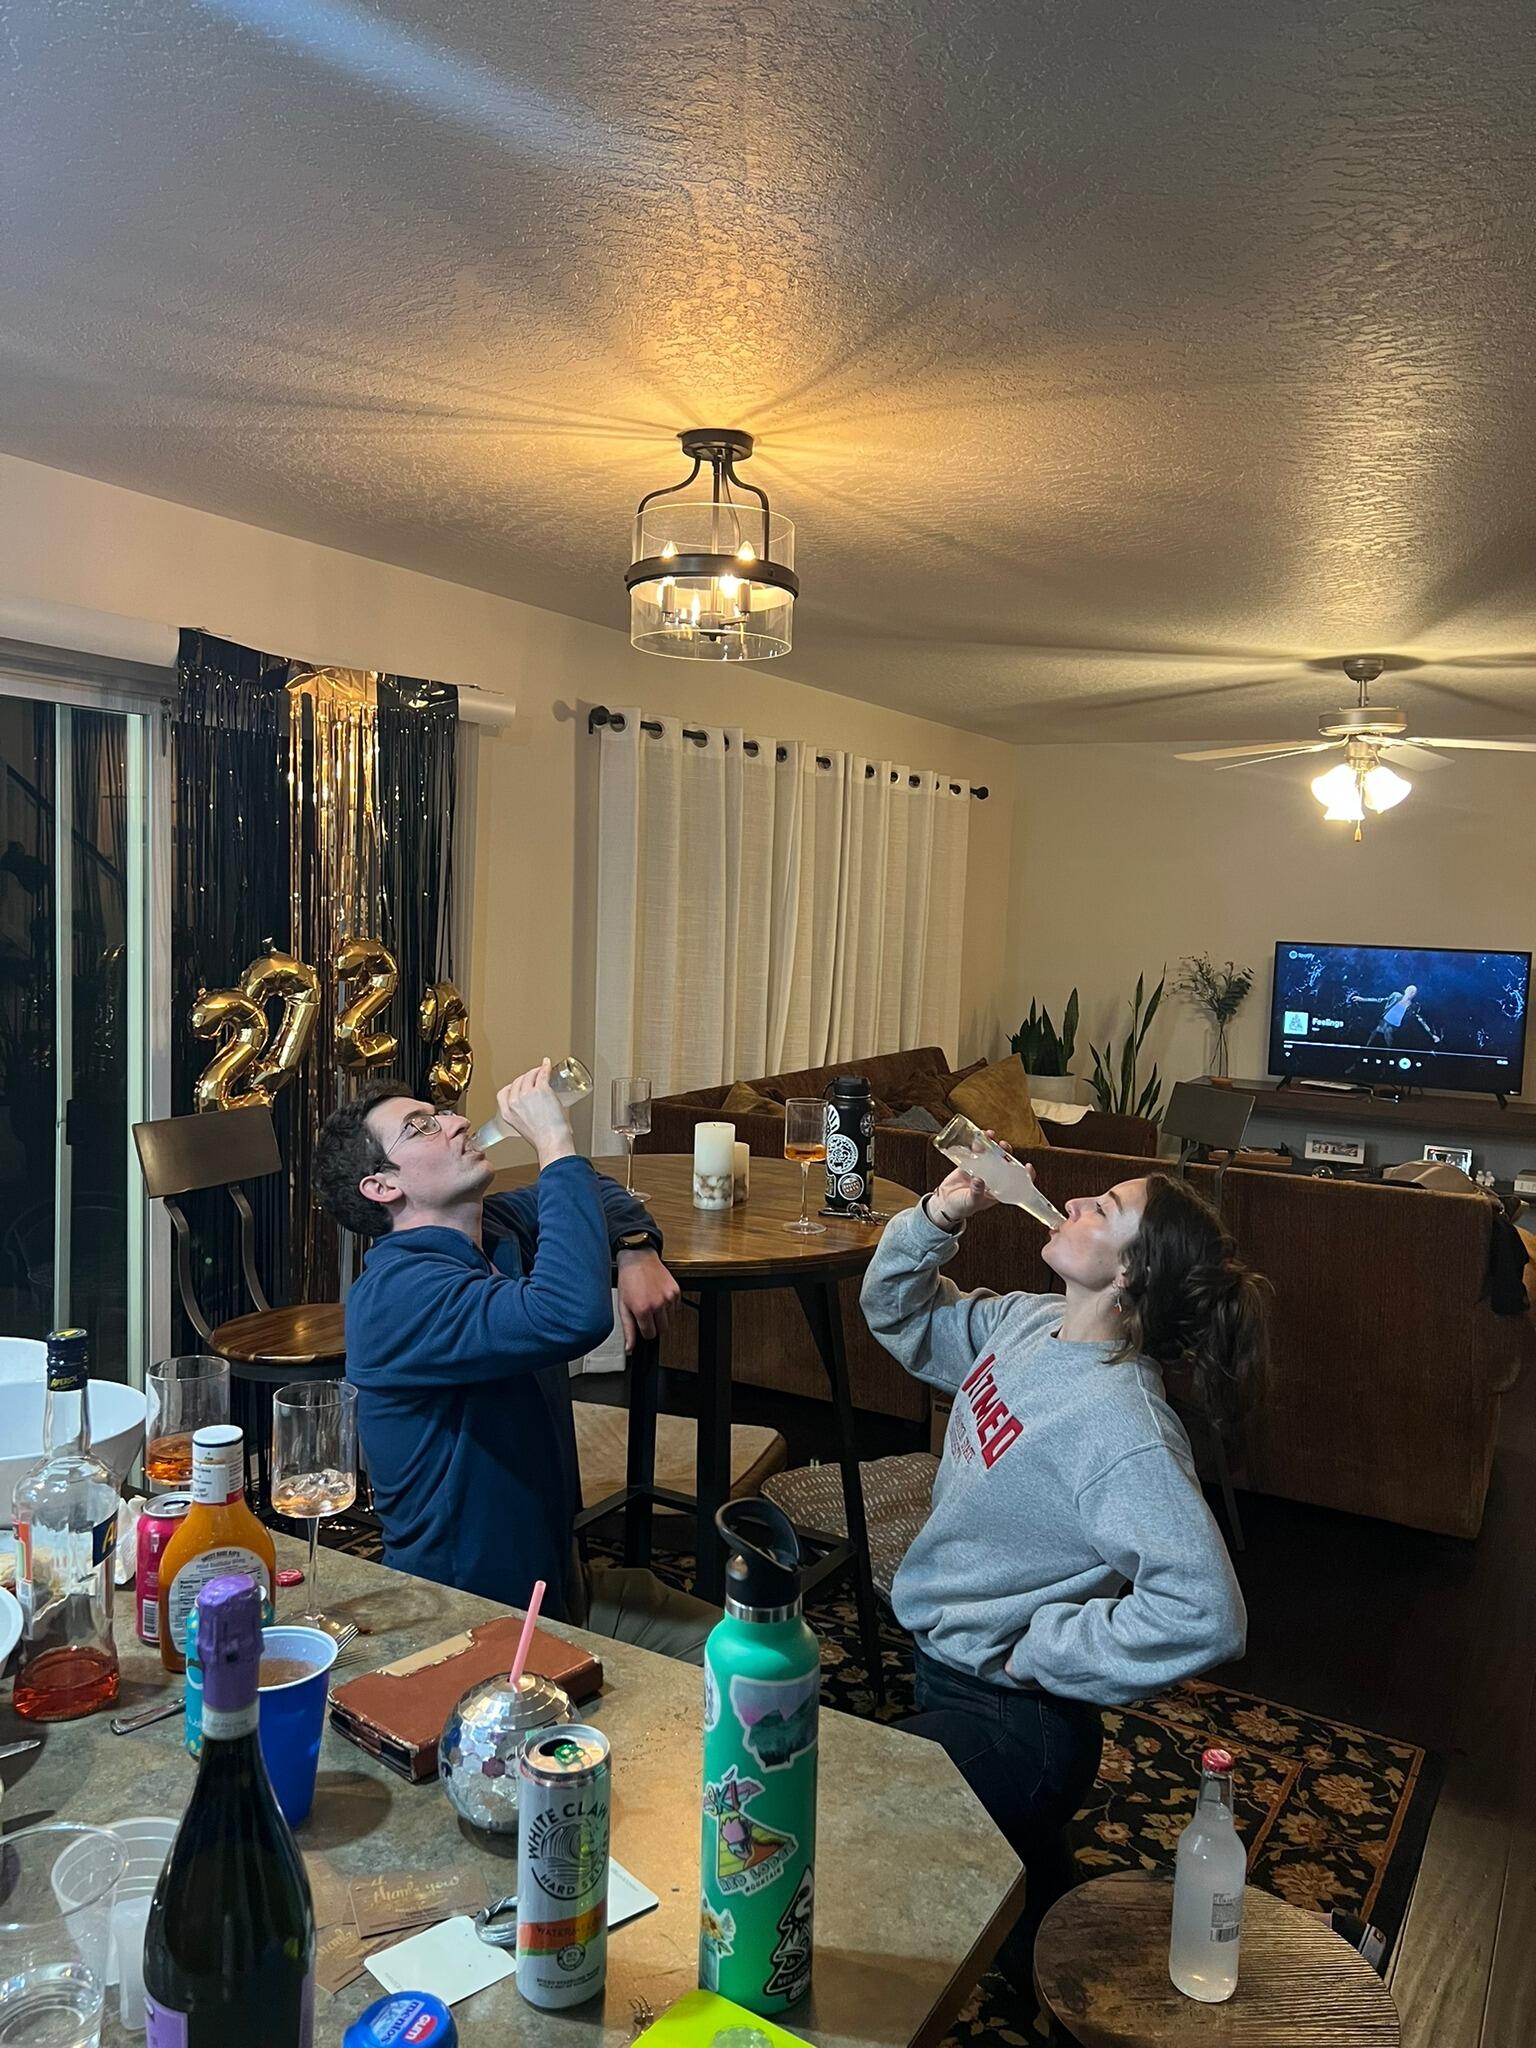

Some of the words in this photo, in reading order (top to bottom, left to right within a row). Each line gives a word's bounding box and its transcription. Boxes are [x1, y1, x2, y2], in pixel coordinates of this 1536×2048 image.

[1312, 1017, 1344, 1029] Feelings
[528, 1808, 559, 1859] WHITE
[563, 1801, 608, 1820] CLAW
[540, 1873, 576, 1895] HARD
[719, 1875, 747, 1892] RED
[381, 2001, 420, 2043] mentos
